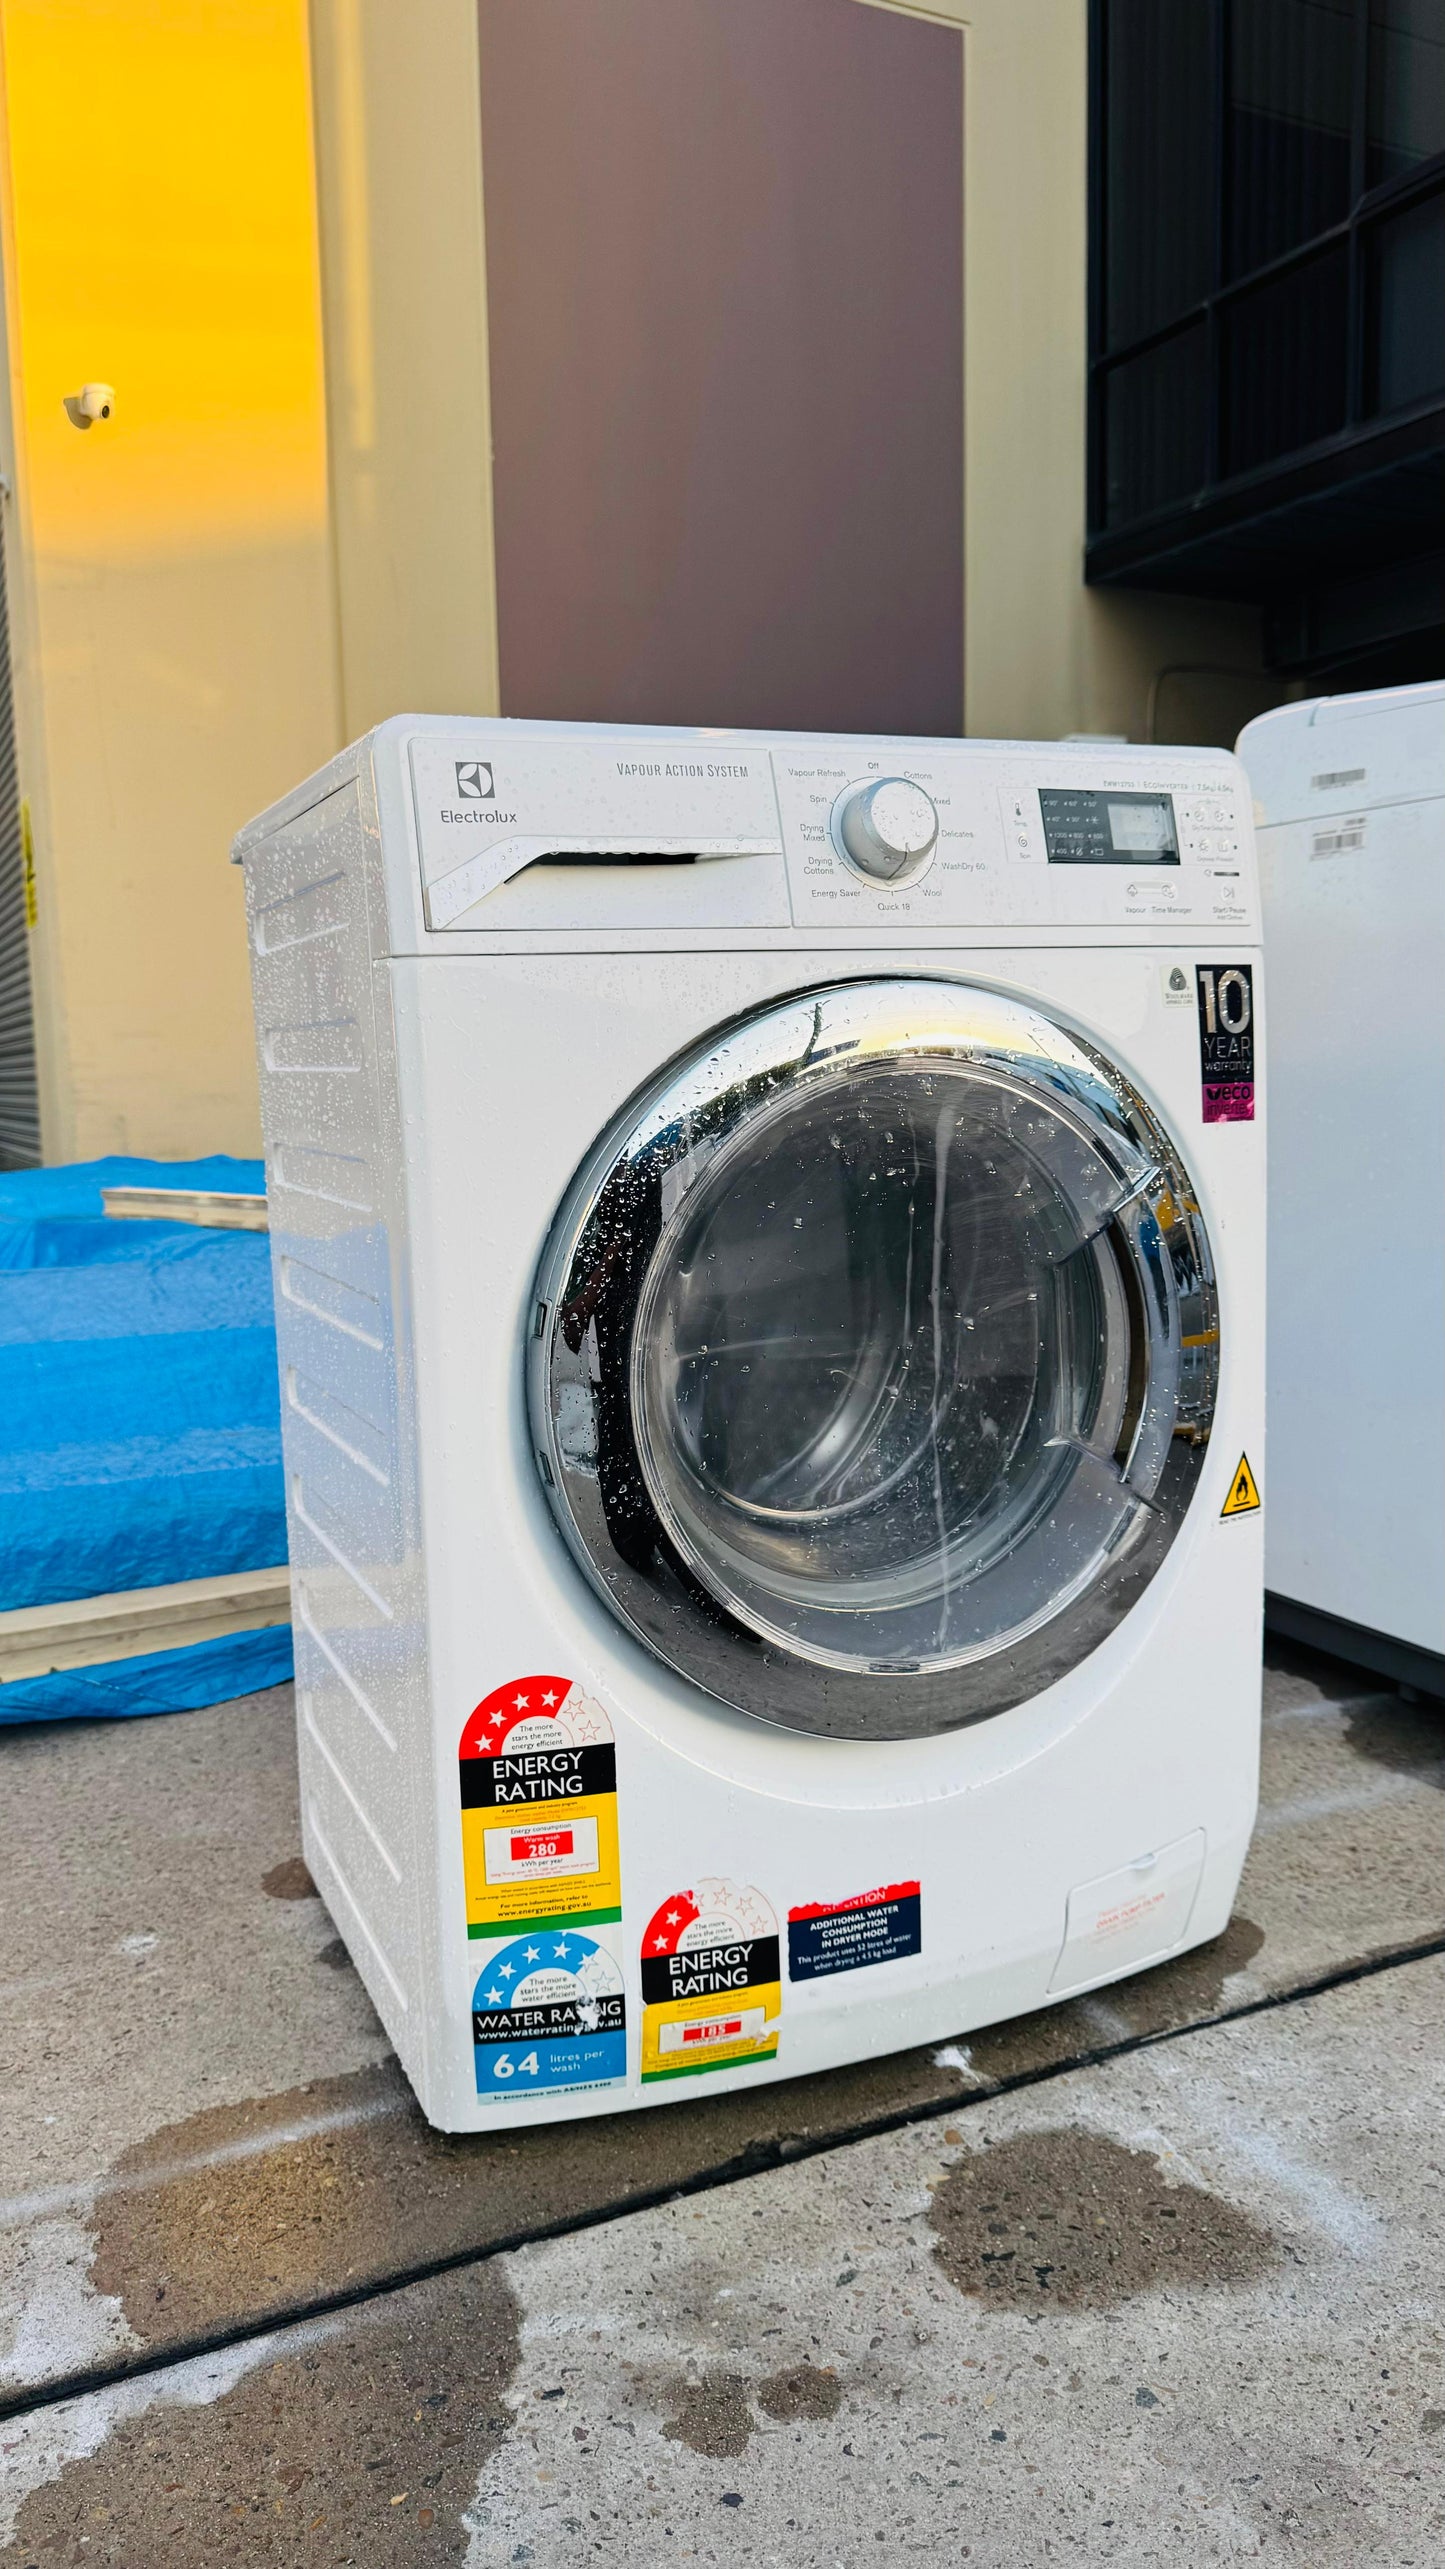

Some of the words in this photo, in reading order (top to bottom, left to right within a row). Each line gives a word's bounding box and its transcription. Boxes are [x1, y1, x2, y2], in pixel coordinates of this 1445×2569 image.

[616, 763, 661, 777] VAPOUR
[665, 764, 704, 777] ACTION
[707, 764, 749, 778] SYSTEM
[788, 769, 816, 777] Vapour
[817, 769, 846, 777] Refresh
[903, 771, 933, 780] Cottons
[810, 795, 827, 804] Spin
[441, 810, 517, 824] Electrolux
[800, 824, 824, 834] Drying
[941, 830, 974, 838] Delicates
[803, 834, 826, 842] Mixed
[808, 857, 832, 867] Drying
[804, 867, 834, 875] Cottons
[811, 890, 837, 899] Energy
[840, 889, 861, 897] Saver
[923, 889, 942, 897] Wool
[878, 903, 899, 911] Quick
[1199, 970, 1250, 1034] 10
[1205, 1036, 1251, 1058] YEAR
[1205, 1059, 1252, 1074] warranty
[1222, 1086, 1251, 1100] eco
[535, 1724, 553, 1732] more
[511, 1734, 528, 1742] stars
[530, 1732, 542, 1740] the
[543, 1731, 562, 1739] more
[511, 1742, 534, 1750] energy
[536, 1739, 563, 1748] efficient
[493, 1751, 583, 1779] ENERGY
[495, 1775, 583, 1802] RATING
[511, 1827, 531, 1836] Energy
[533, 1823, 571, 1832] consumption
[524, 1836, 544, 1844] Warm
[545, 1834, 560, 1842] wash
[529, 1843, 557, 1857] 280
[522, 1860, 536, 1868] kWh
[538, 1859, 548, 1867] per
[550, 1858, 563, 1866] year
[498, 1902, 591, 1917] www.energyrating.gov.au
[810, 1911, 865, 1931] ADDITIONAL
[867, 1905, 899, 1918] WATER
[686, 1932, 702, 1940] stars
[715, 1927, 733, 1935] more
[822, 1917, 888, 1939] CONSUMPTION
[686, 1939, 708, 1948] energy
[709, 1934, 735, 1944] efficient
[822, 1940, 832, 1949] IN
[833, 1933, 862, 1946] DRYER
[863, 1927, 889, 1940] MODE
[797, 1956, 812, 1965] This
[813, 1949, 840, 1962] product
[841, 1948, 856, 1956] uses
[893, 1933, 912, 1943] water
[669, 1944, 753, 1975] ENERGY
[814, 1962, 833, 1971] when
[834, 1957, 855, 1967] drying
[529, 1978, 544, 1986] The
[672, 1967, 748, 1997] RATING
[520, 1987, 539, 1995] stars
[556, 1983, 577, 1991] more
[522, 1995, 545, 2003] water
[546, 1990, 576, 2000] efficient
[477, 2011, 545, 2029] WATER
[551, 2001, 621, 2022] RANG
[494, 2052, 540, 2078] 64
[550, 2053, 580, 2064] litres
[584, 2050, 605, 2062] per
[550, 2063, 580, 2073] wash
